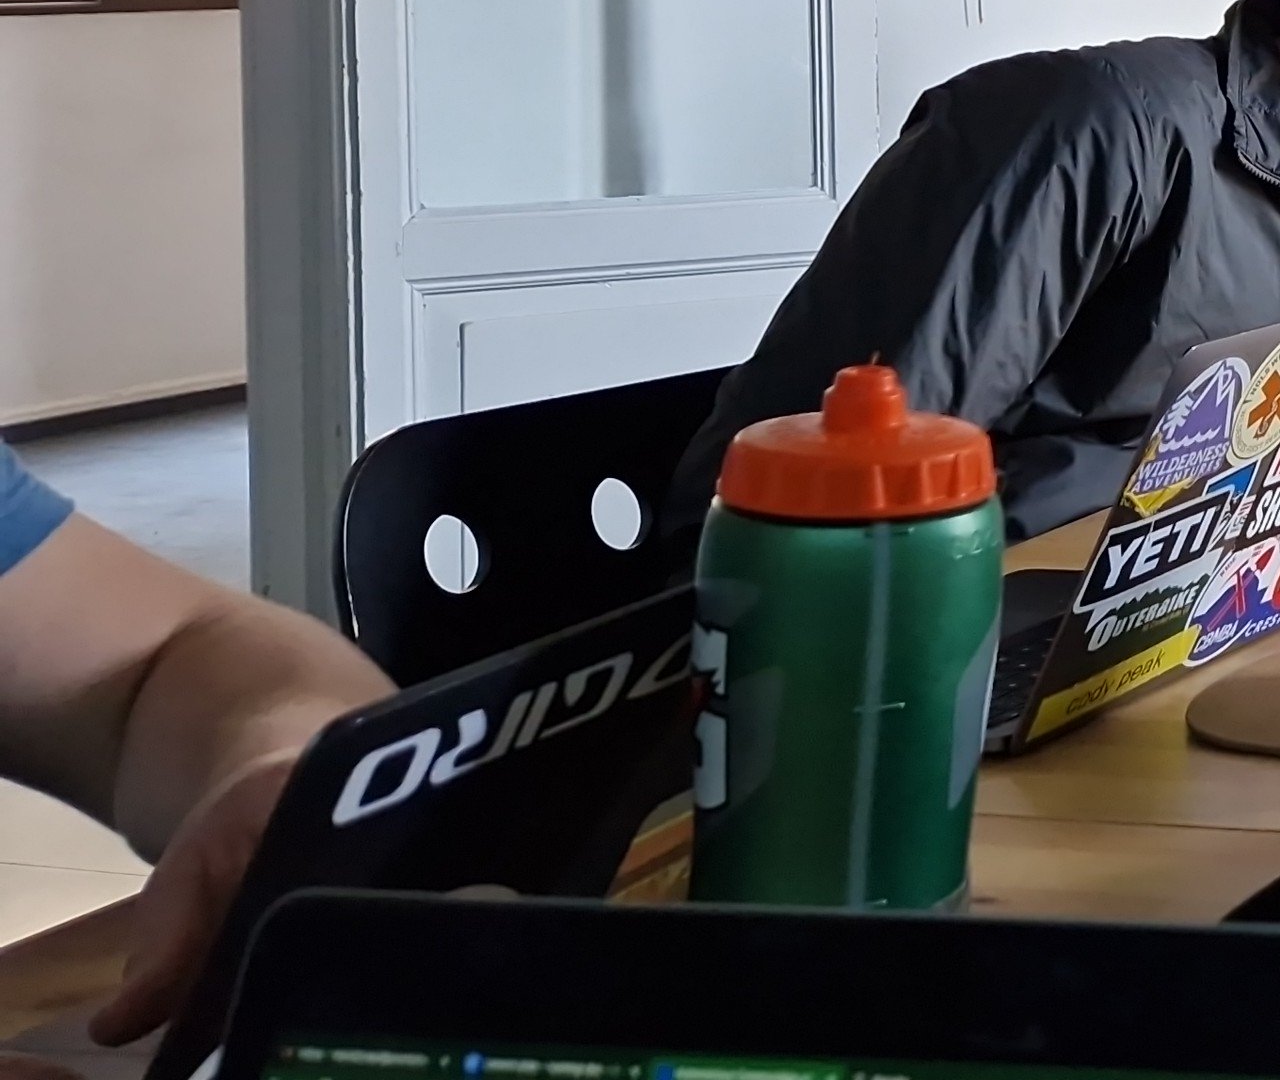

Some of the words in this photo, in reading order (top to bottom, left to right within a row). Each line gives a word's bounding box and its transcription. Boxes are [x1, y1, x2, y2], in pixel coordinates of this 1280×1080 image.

[1138, 441, 1229, 481] WILDERNESS
[1103, 508, 1216, 590] YETI
[1087, 584, 1200, 652] OUTERBIKE
[1116, 649, 1165, 691] peak
[331, 650, 634, 828] GIRO
